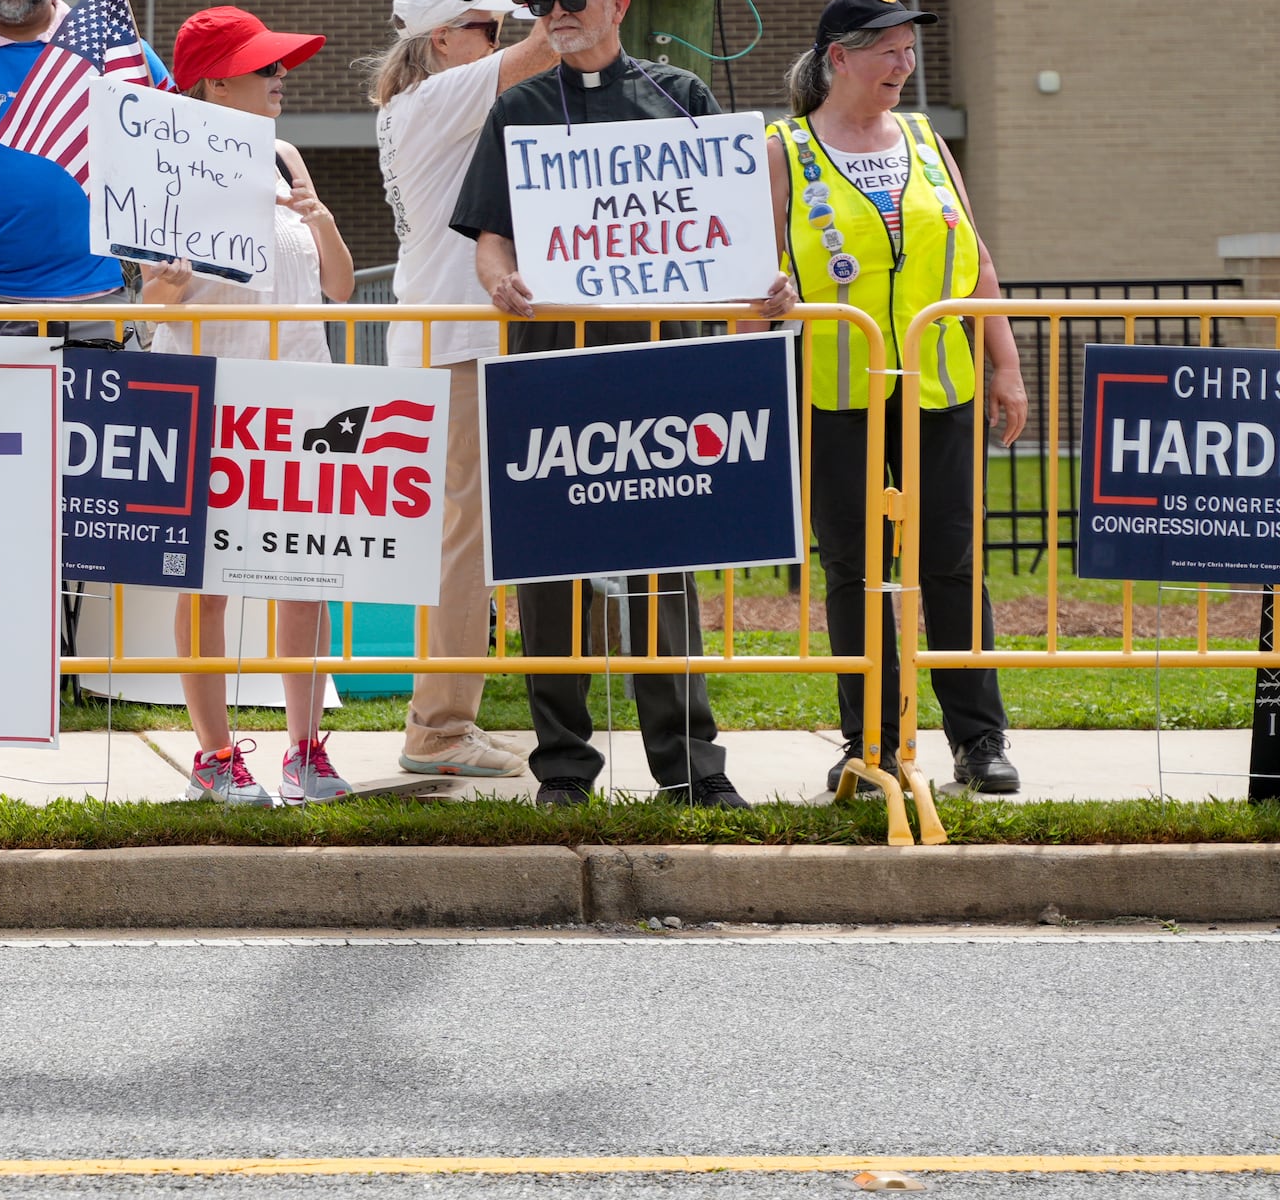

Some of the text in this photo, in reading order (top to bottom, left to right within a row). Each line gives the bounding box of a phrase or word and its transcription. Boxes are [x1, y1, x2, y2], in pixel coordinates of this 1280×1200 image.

[157, 148, 181, 196] by
[511, 134, 756, 190] IMMIGRANTS
[846, 156, 909, 174] KINGS
[854, 172, 908, 189] MERIC
[592, 187, 698, 220] MAKE
[104, 185, 267, 273] Midterms
[546, 215, 732, 262] AMERICA
[576, 258, 715, 296] GREAT
[506, 409, 771, 481] JACKSON
[1111, 418, 1278, 477] HARD
[568, 474, 713, 505] GOVERNOR
[1164, 495, 1188, 511] US
[75, 520, 160, 543] DISTRICT
[165, 526, 190, 545] 11
[1092, 515, 1251, 537] CONGRESSIONAL
[213, 529, 397, 559] S. SENATE
